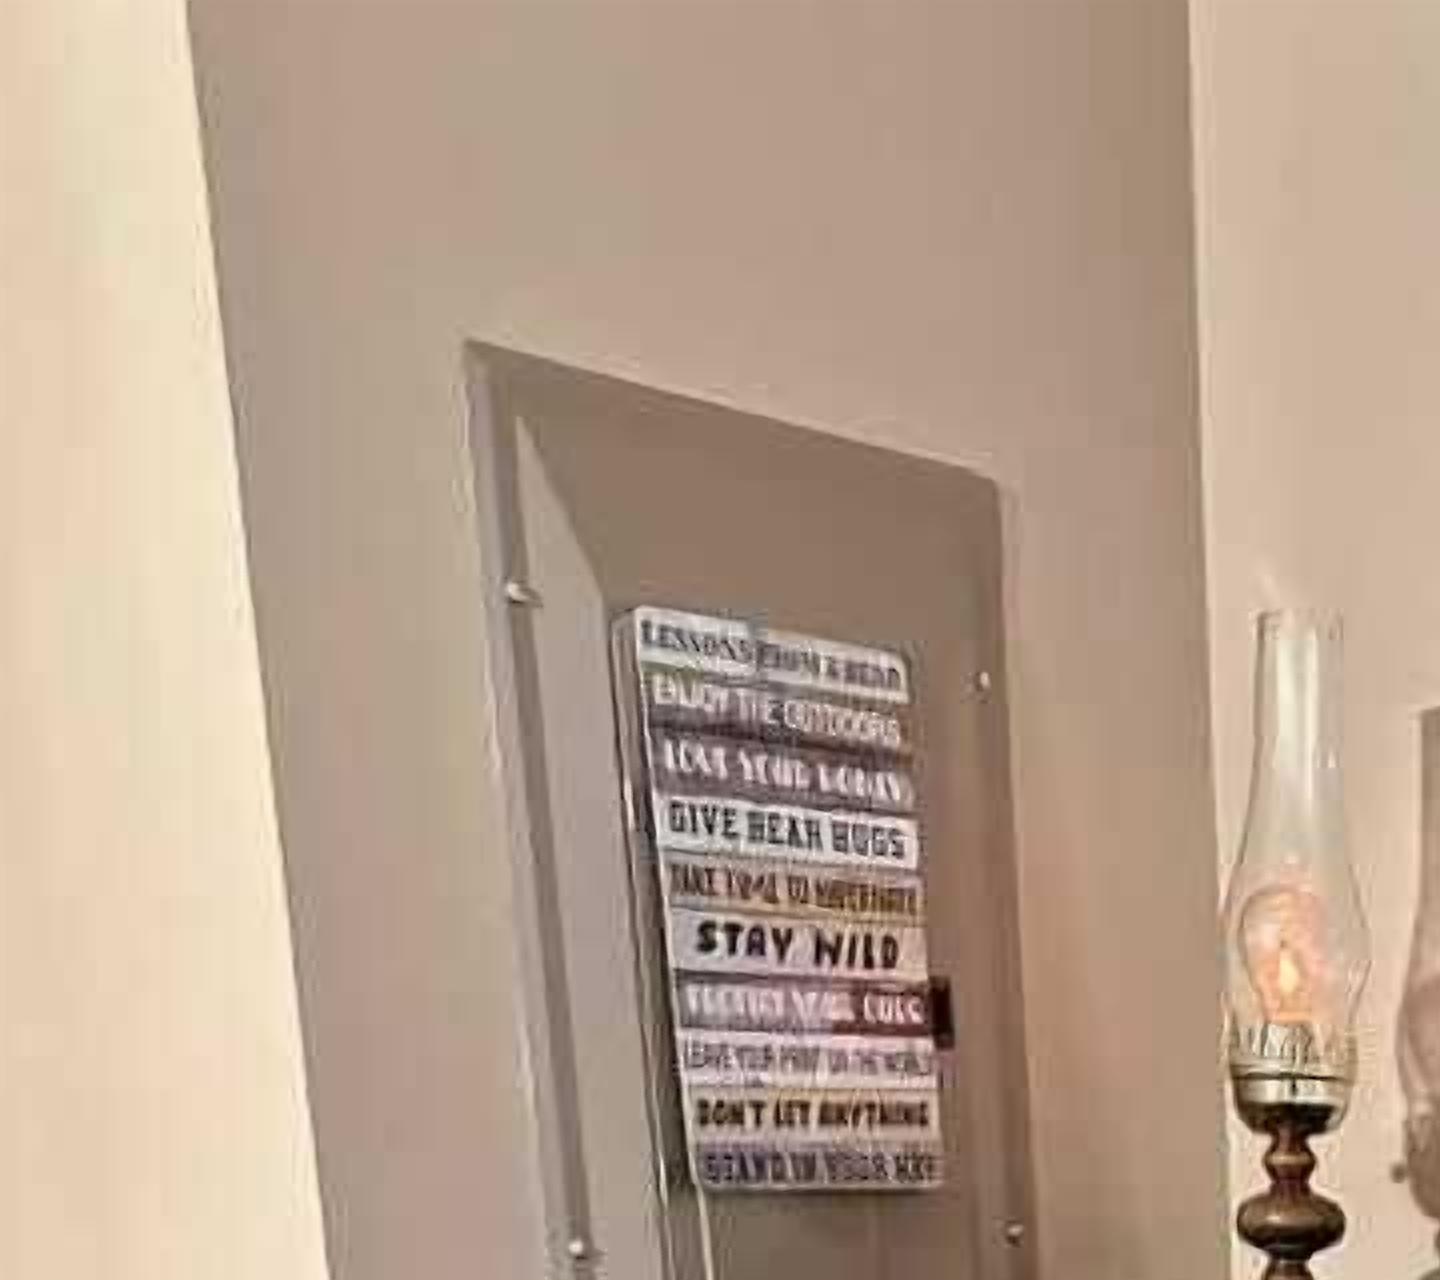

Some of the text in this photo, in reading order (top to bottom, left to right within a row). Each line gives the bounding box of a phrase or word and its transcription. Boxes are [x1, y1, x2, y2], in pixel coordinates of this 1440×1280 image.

[669, 801, 906, 860] GIVE BEAR HUGS
[697, 920, 899, 970] STAY WILD
